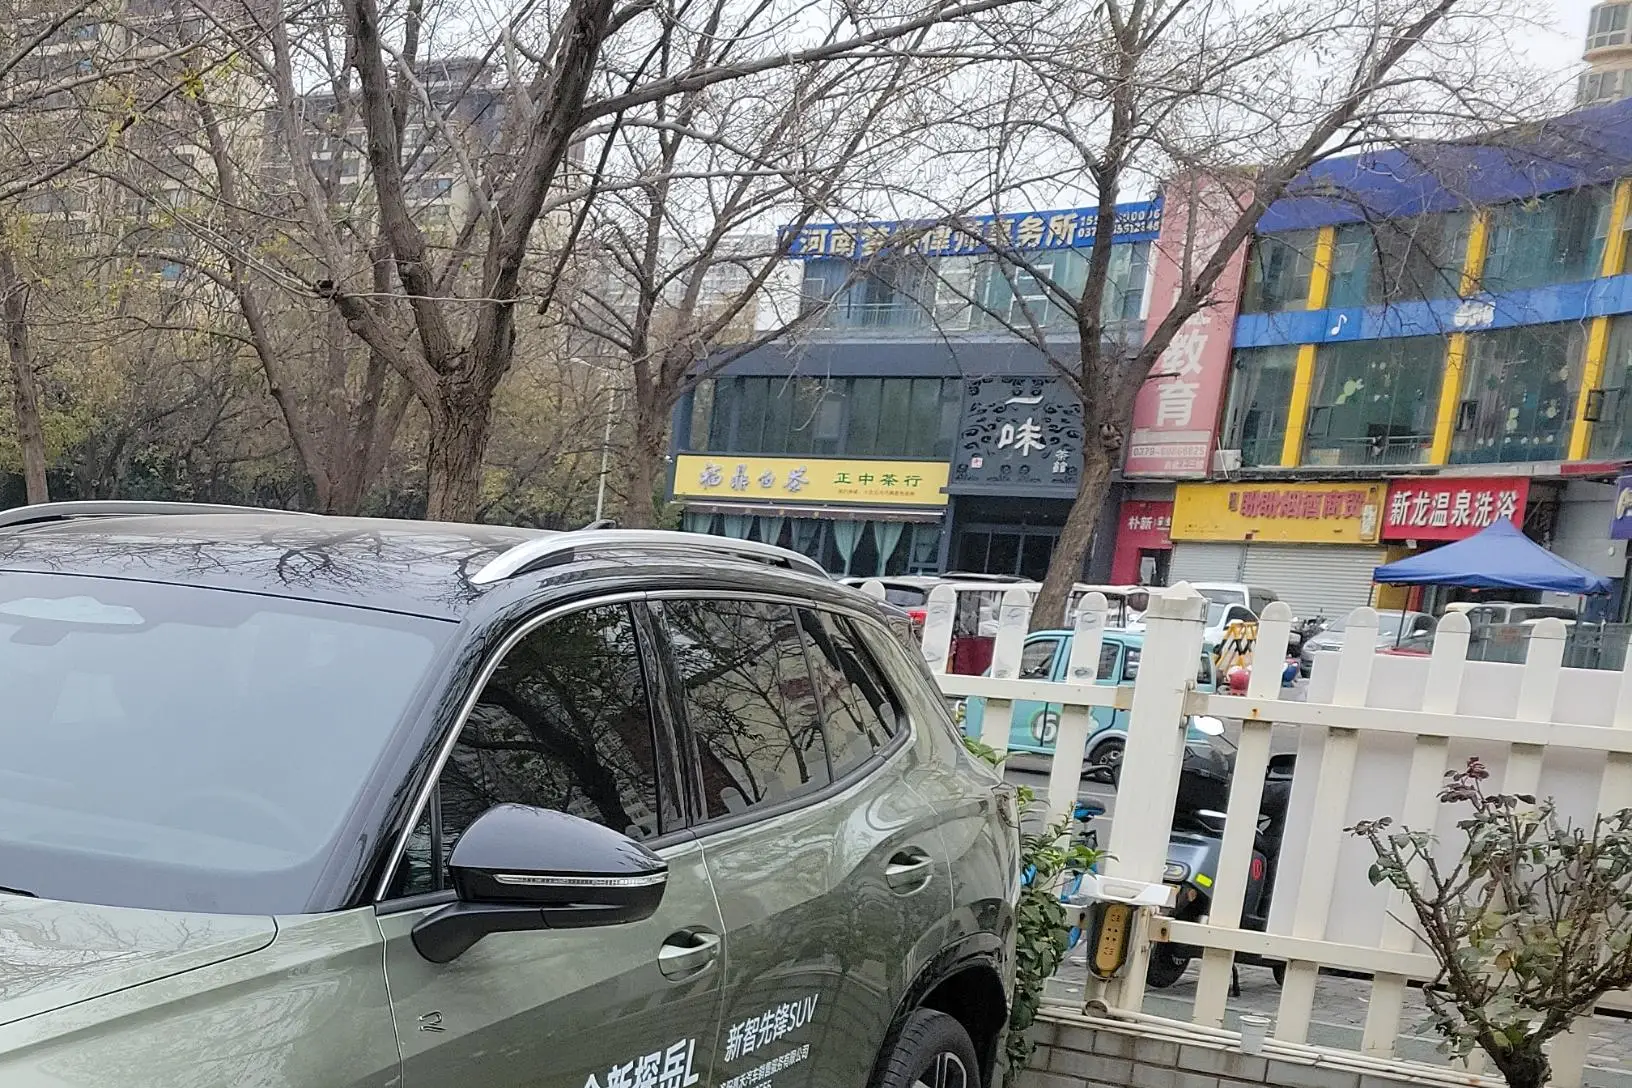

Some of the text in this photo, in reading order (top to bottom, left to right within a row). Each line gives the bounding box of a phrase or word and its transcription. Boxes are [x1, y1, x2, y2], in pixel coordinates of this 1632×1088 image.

[799, 212, 1079, 256] 河南律师事务所
[834, 472, 923, 487] 正中茶行
[1390, 490, 1519, 526] 新龙温泉洗浴
[724, 994, 818, 1062] 新智先锋SUV
